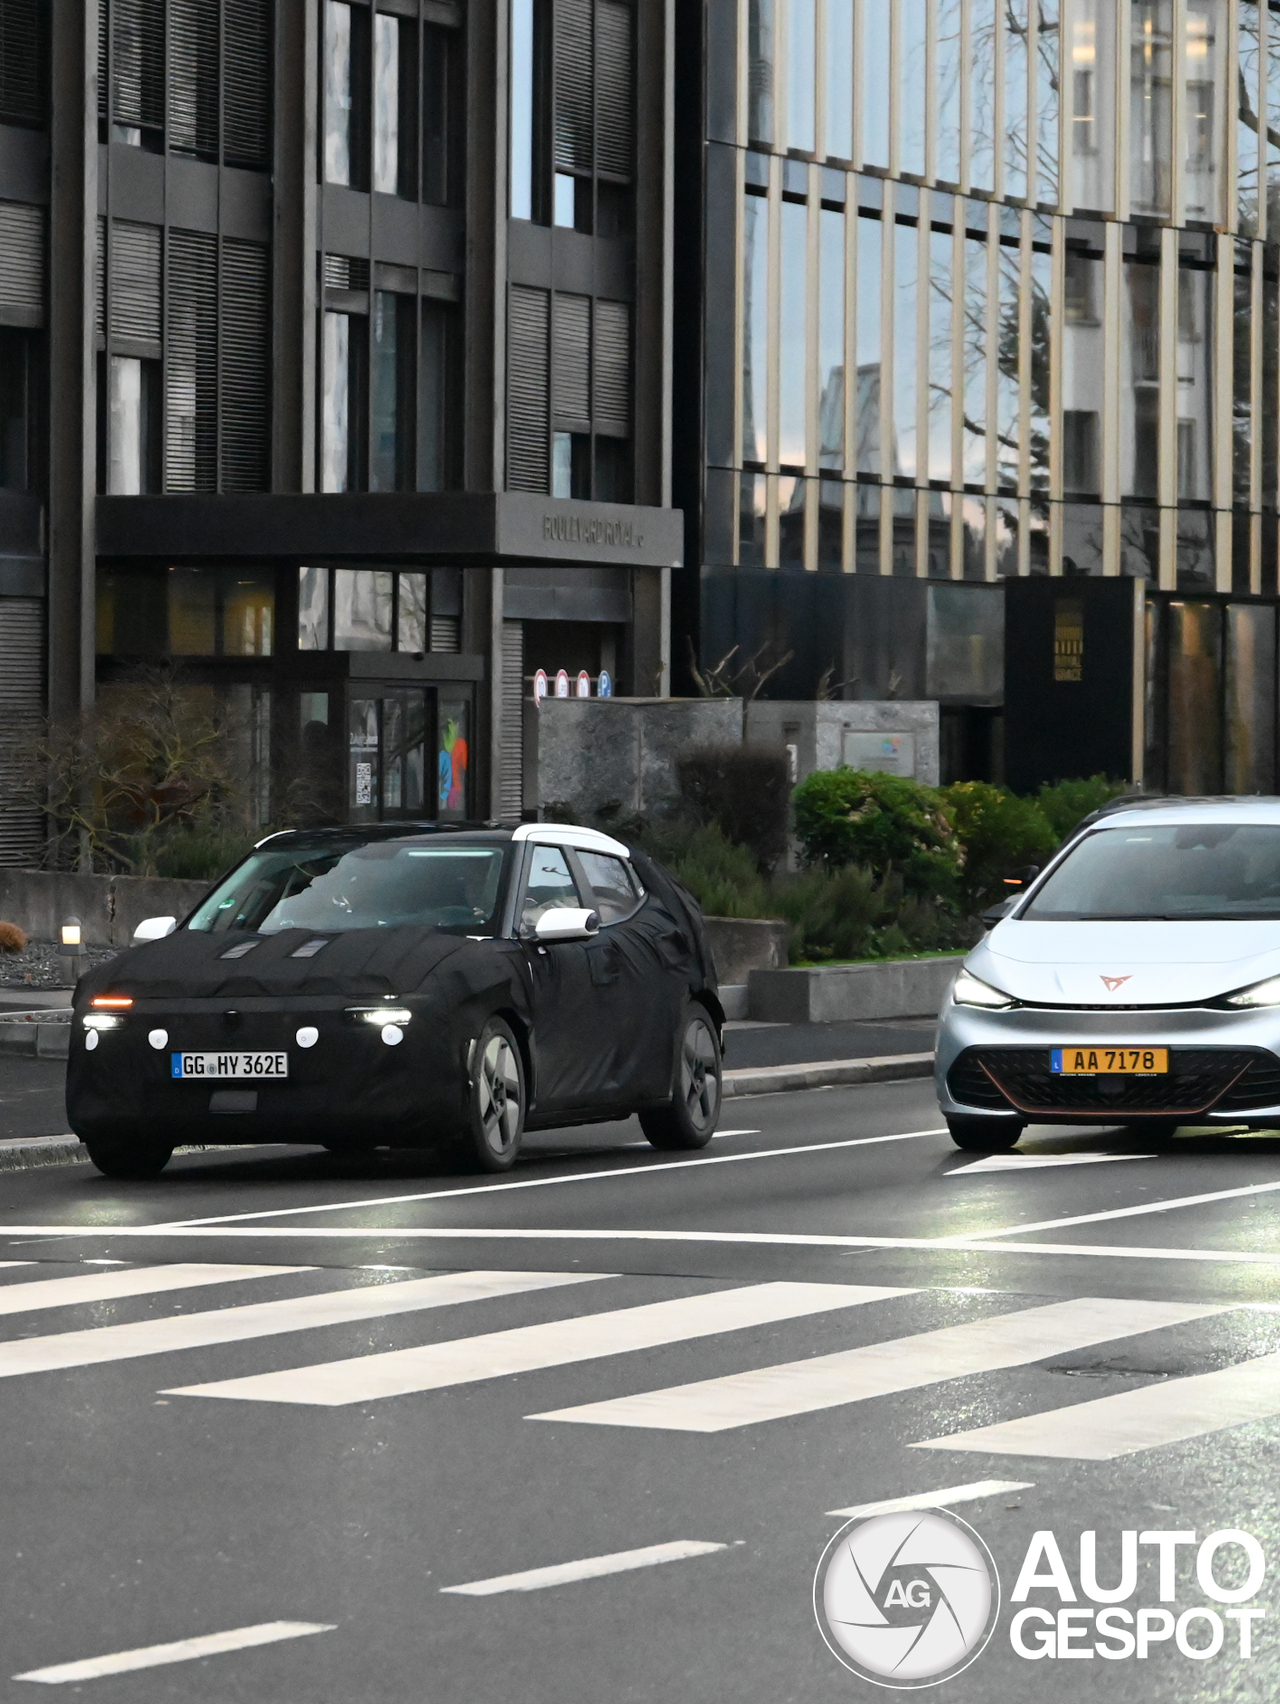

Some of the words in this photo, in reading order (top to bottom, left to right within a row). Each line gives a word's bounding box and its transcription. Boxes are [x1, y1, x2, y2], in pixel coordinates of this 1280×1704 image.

[543, 514, 603, 544] BOULEVARD
[604, 519, 635, 547] ROYAL
[183, 1055, 205, 1075] GG
[217, 1055, 239, 1075] HY
[243, 1055, 286, 1075] 362E
[1074, 1051, 1099, 1070] AA
[1105, 1051, 1155, 1070] 7178
